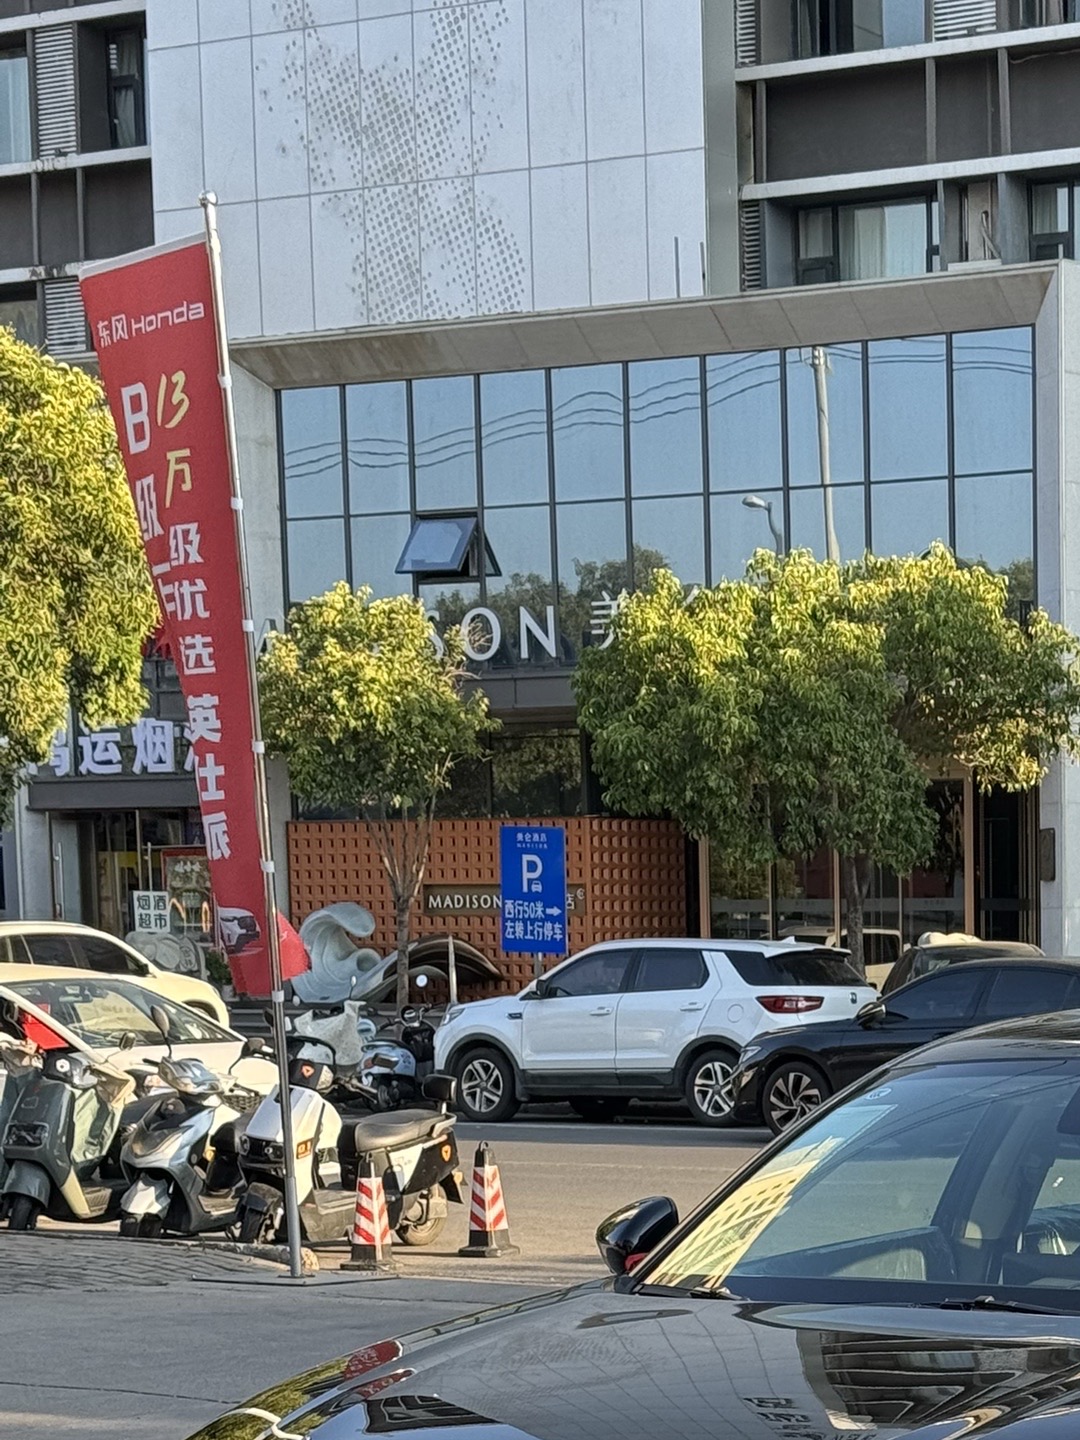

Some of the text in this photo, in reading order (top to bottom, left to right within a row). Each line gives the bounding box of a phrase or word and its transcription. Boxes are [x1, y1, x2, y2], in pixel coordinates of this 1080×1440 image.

[97, 300, 205, 348] 东风 Honda
[30, 716, 196, 777] 运烟
[522, 853, 543, 893] P
[428, 894, 502, 909] MADISON
[504, 899, 545, 919] 西行50米
[138, 913, 168, 930] 超市
[504, 920, 563, 942] 左转上行停车
